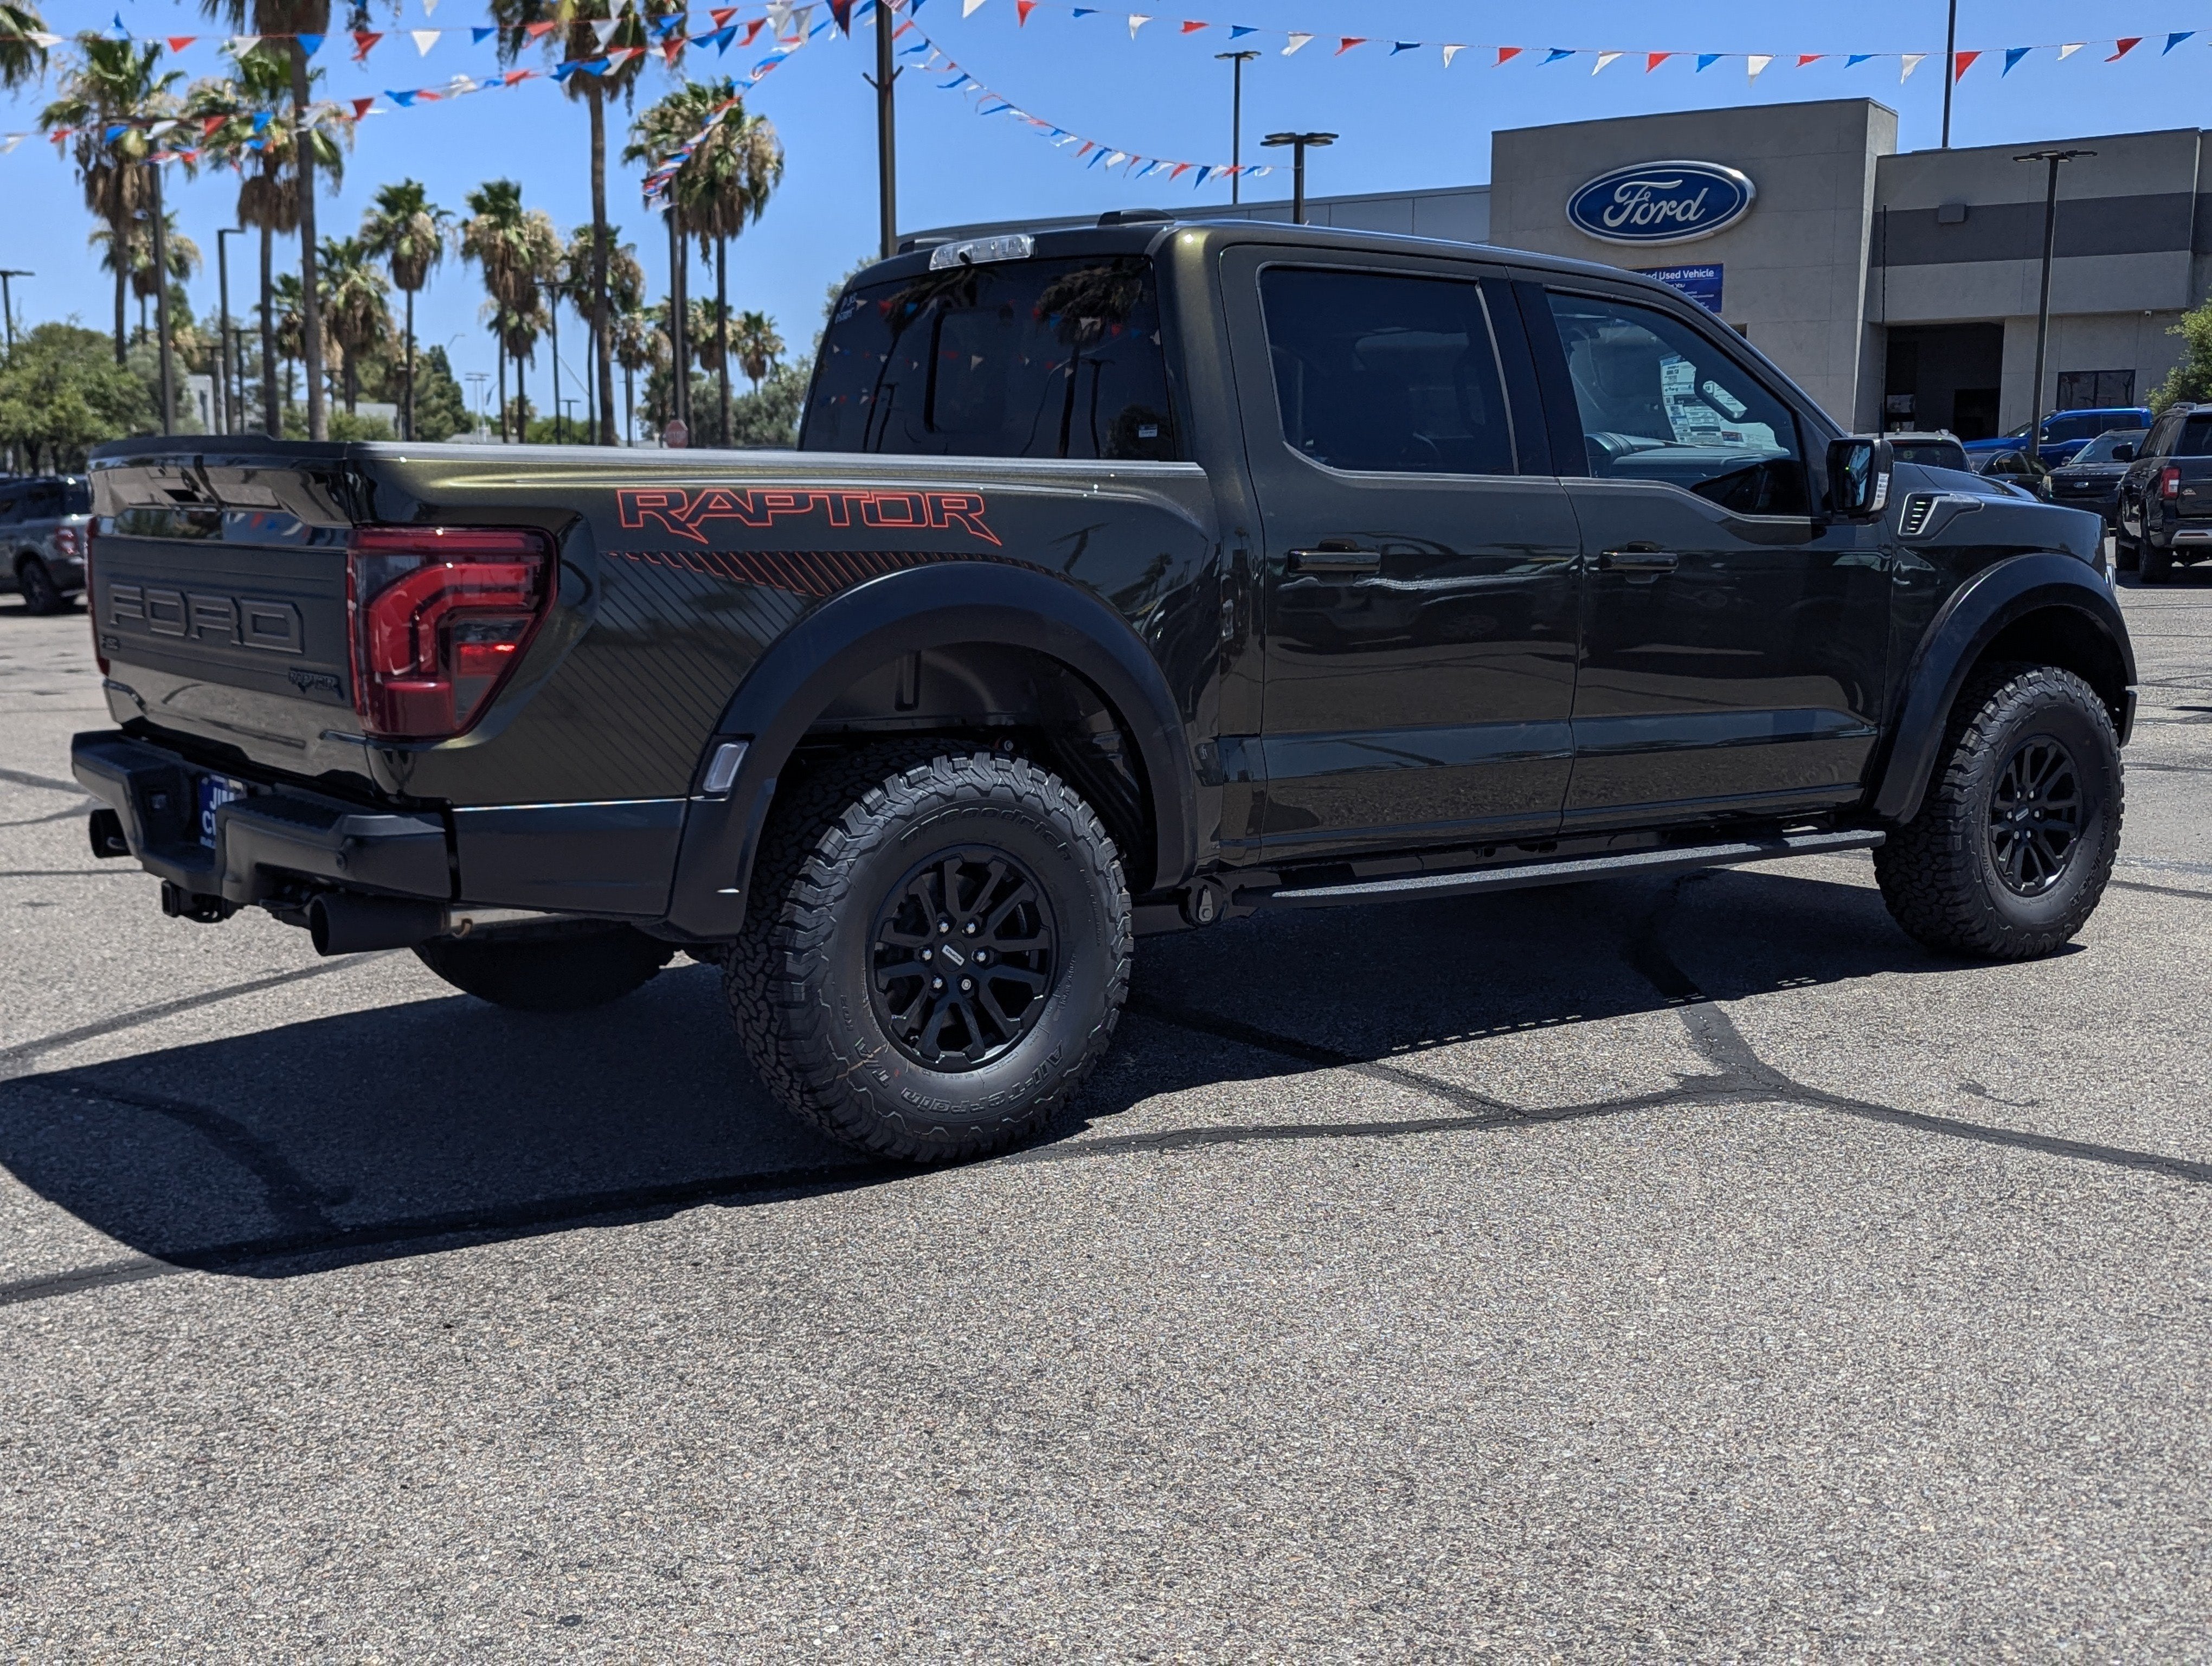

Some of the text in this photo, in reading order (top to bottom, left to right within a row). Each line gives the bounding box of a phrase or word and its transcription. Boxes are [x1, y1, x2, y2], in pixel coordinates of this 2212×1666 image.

[1603, 180, 1708, 227] Ford
[1659, 270, 1681, 280] Used
[1683, 268, 1714, 278] Vehicle
[615, 488, 1003, 546] RAPTOR
[109, 584, 305, 655] FORD
